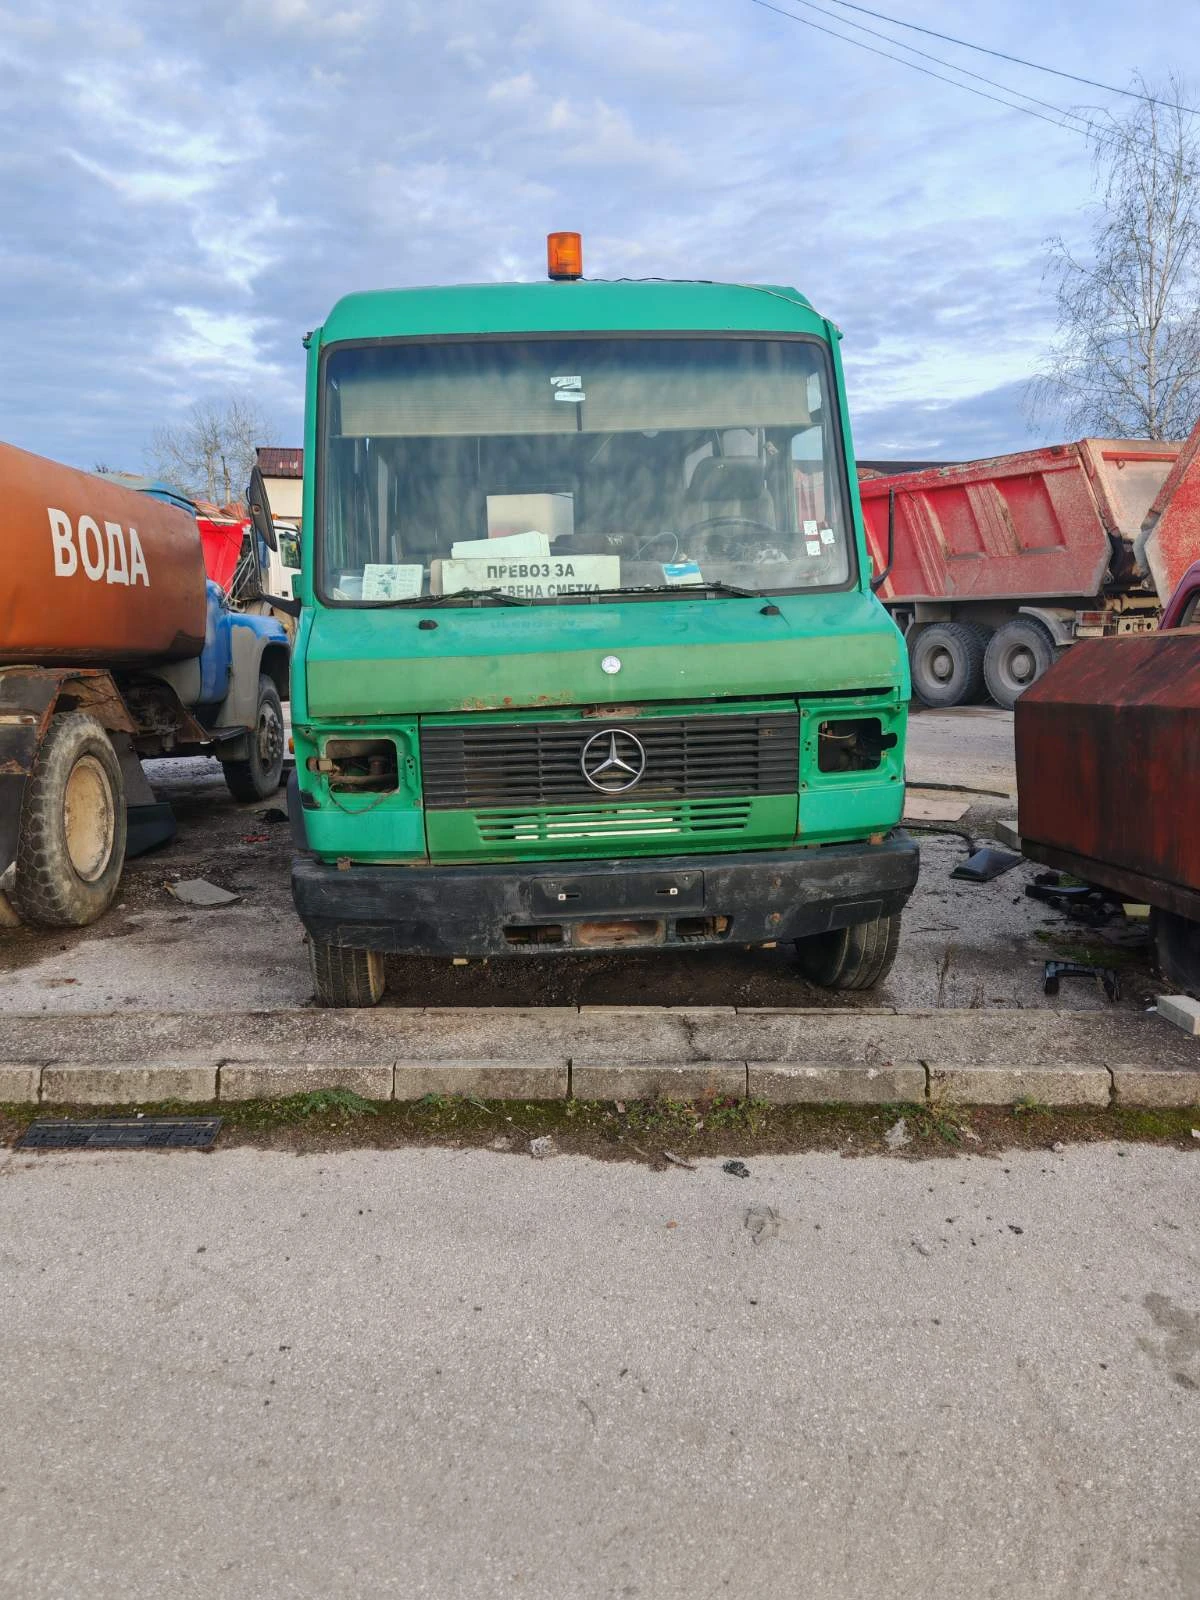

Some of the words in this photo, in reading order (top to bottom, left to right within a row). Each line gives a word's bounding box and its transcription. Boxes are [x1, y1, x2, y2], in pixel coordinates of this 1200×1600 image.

[47, 507, 150, 587] ВОДА
[487, 563, 550, 579] ПРЕВОЗ
[554, 563, 575, 577] ЗА
